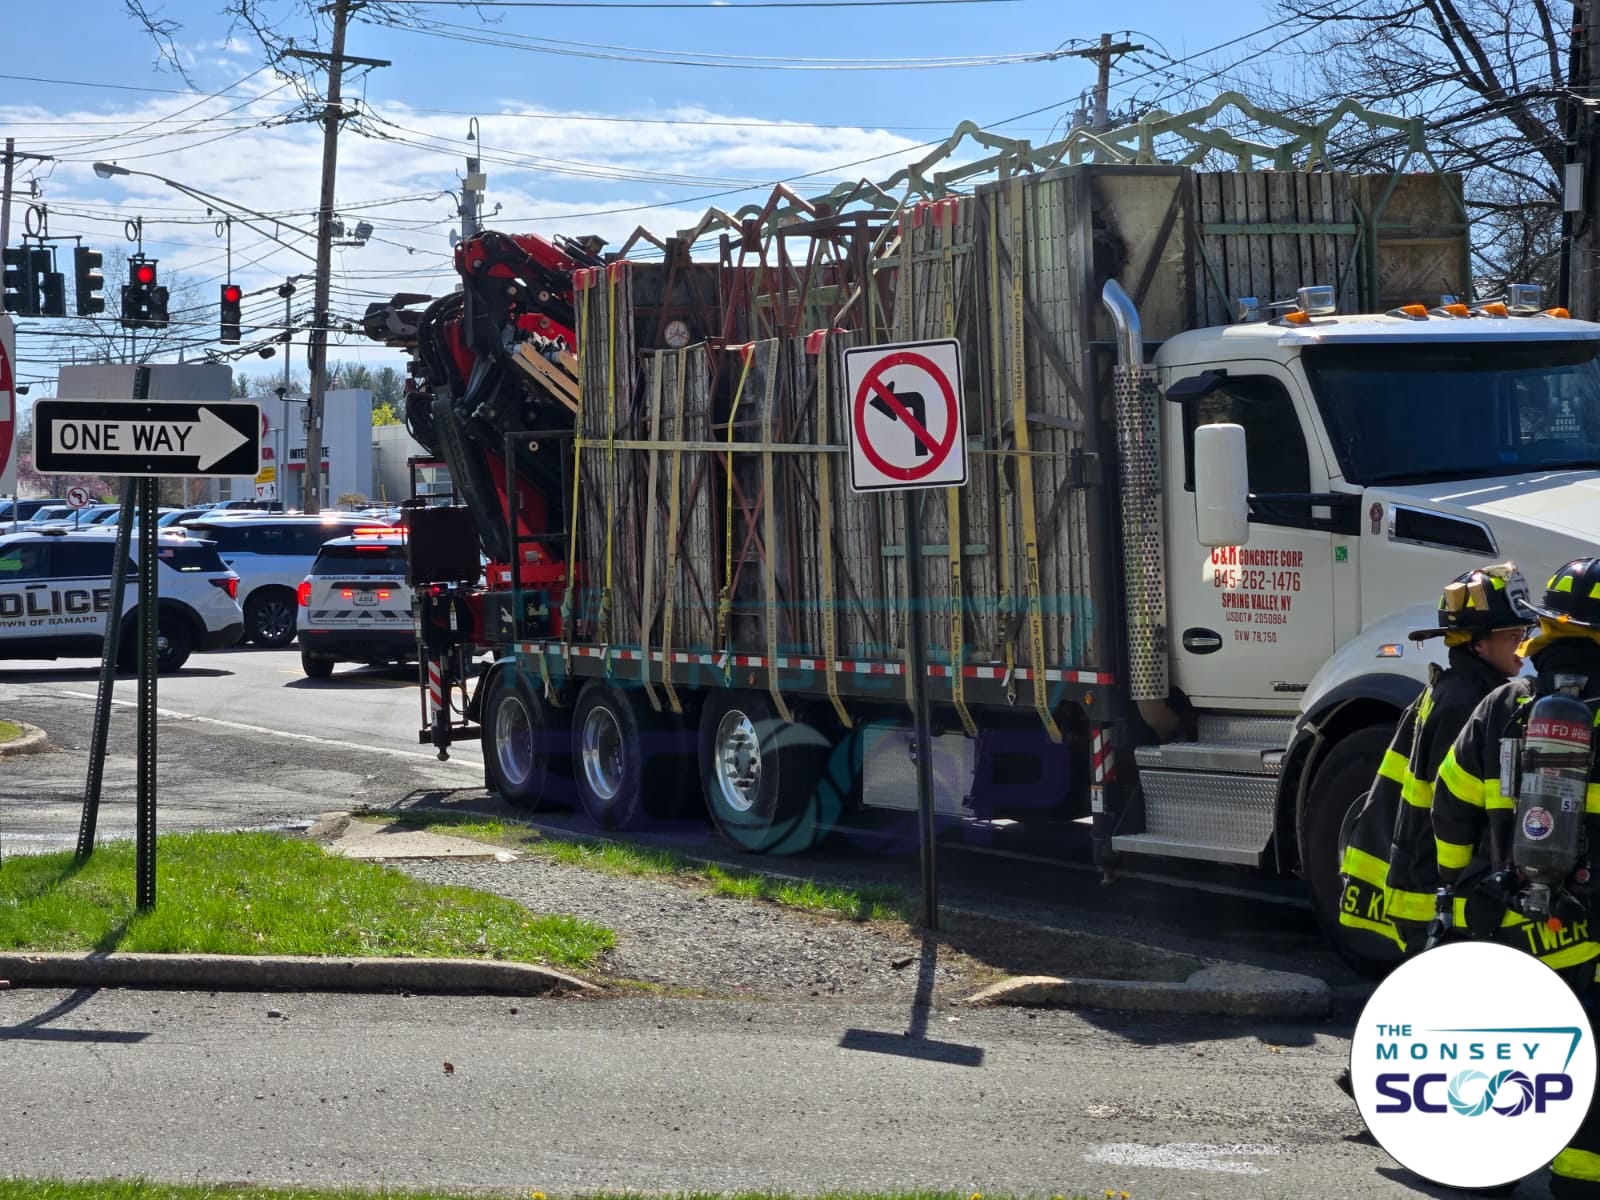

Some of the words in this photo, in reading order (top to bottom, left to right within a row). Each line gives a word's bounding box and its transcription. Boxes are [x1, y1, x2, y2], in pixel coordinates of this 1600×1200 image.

[59, 424, 120, 450] ONE
[133, 425, 192, 452] WAY
[1239, 549, 1278, 567] CONCRETE
[1280, 549, 1304, 568] CORP.
[1214, 569, 1301, 591] 845-262-1476
[1222, 593, 1250, 609] SPRING
[1251, 594, 1279, 612] VALLEY,
[1281, 596, 1292, 611] NY
[30, 619, 45, 627] OF
[48, 616, 97, 625] RAMAPO
[1226, 611, 1252, 623] USDOT#
[1234, 630, 1250, 641] GVW
[1252, 631, 1277, 643] 78,750
[1033, 638, 1042, 675] CARGO
[1552, 725, 1568, 736] FD
[1344, 885, 1360, 914] S.
